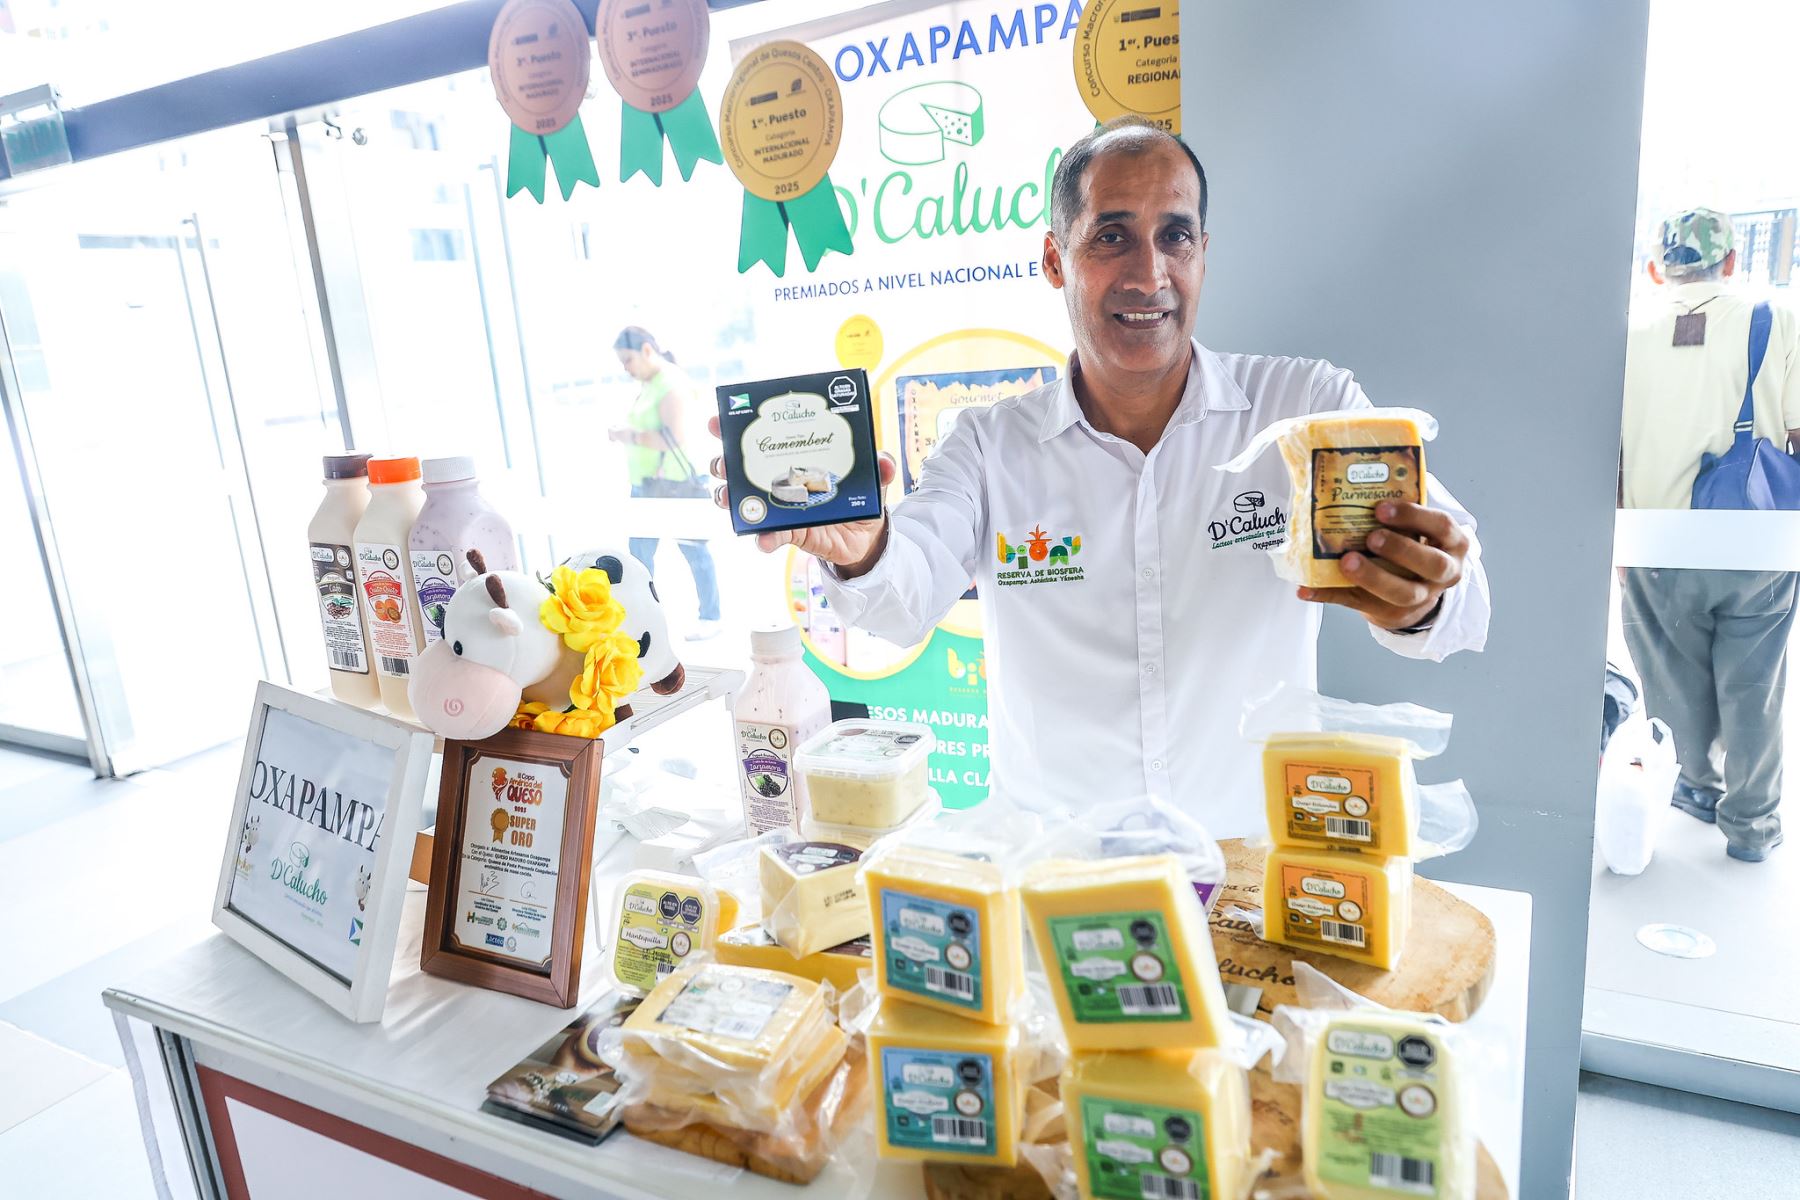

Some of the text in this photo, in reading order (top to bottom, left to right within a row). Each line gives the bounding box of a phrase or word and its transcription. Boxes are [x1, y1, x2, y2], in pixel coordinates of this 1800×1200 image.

[1083, 43, 1101, 98] Concurso
[768, 108, 807, 125] Puesto
[753, 136, 810, 156] INTERNACIONAL
[762, 149, 804, 165] MADURADO
[774, 181, 800, 196] 2025
[774, 261, 1038, 302] PREMIADOS A NIVEL NACIONAL E
[757, 432, 833, 453] Camembert
[1331, 486, 1405, 502] Parmesano
[997, 566, 1084, 580] RESERVA DE BIOSFERA
[509, 777, 543, 789] América del
[521, 773, 535, 781] Copa
[1310, 780, 1348, 791] D'Calucho
[507, 784, 543, 806] QUESO
[509, 815, 537, 831] SUPER
[511, 829, 534, 848] ORO
[494, 853, 508, 861] QUESO
[526, 859, 549, 868] OXAPAMPA
[270, 856, 328, 905] D'Calucho
[1305, 881, 1342, 896] D'Calucho
[1242, 885, 1260, 893] de
[625, 931, 661, 945] Mantequilla
